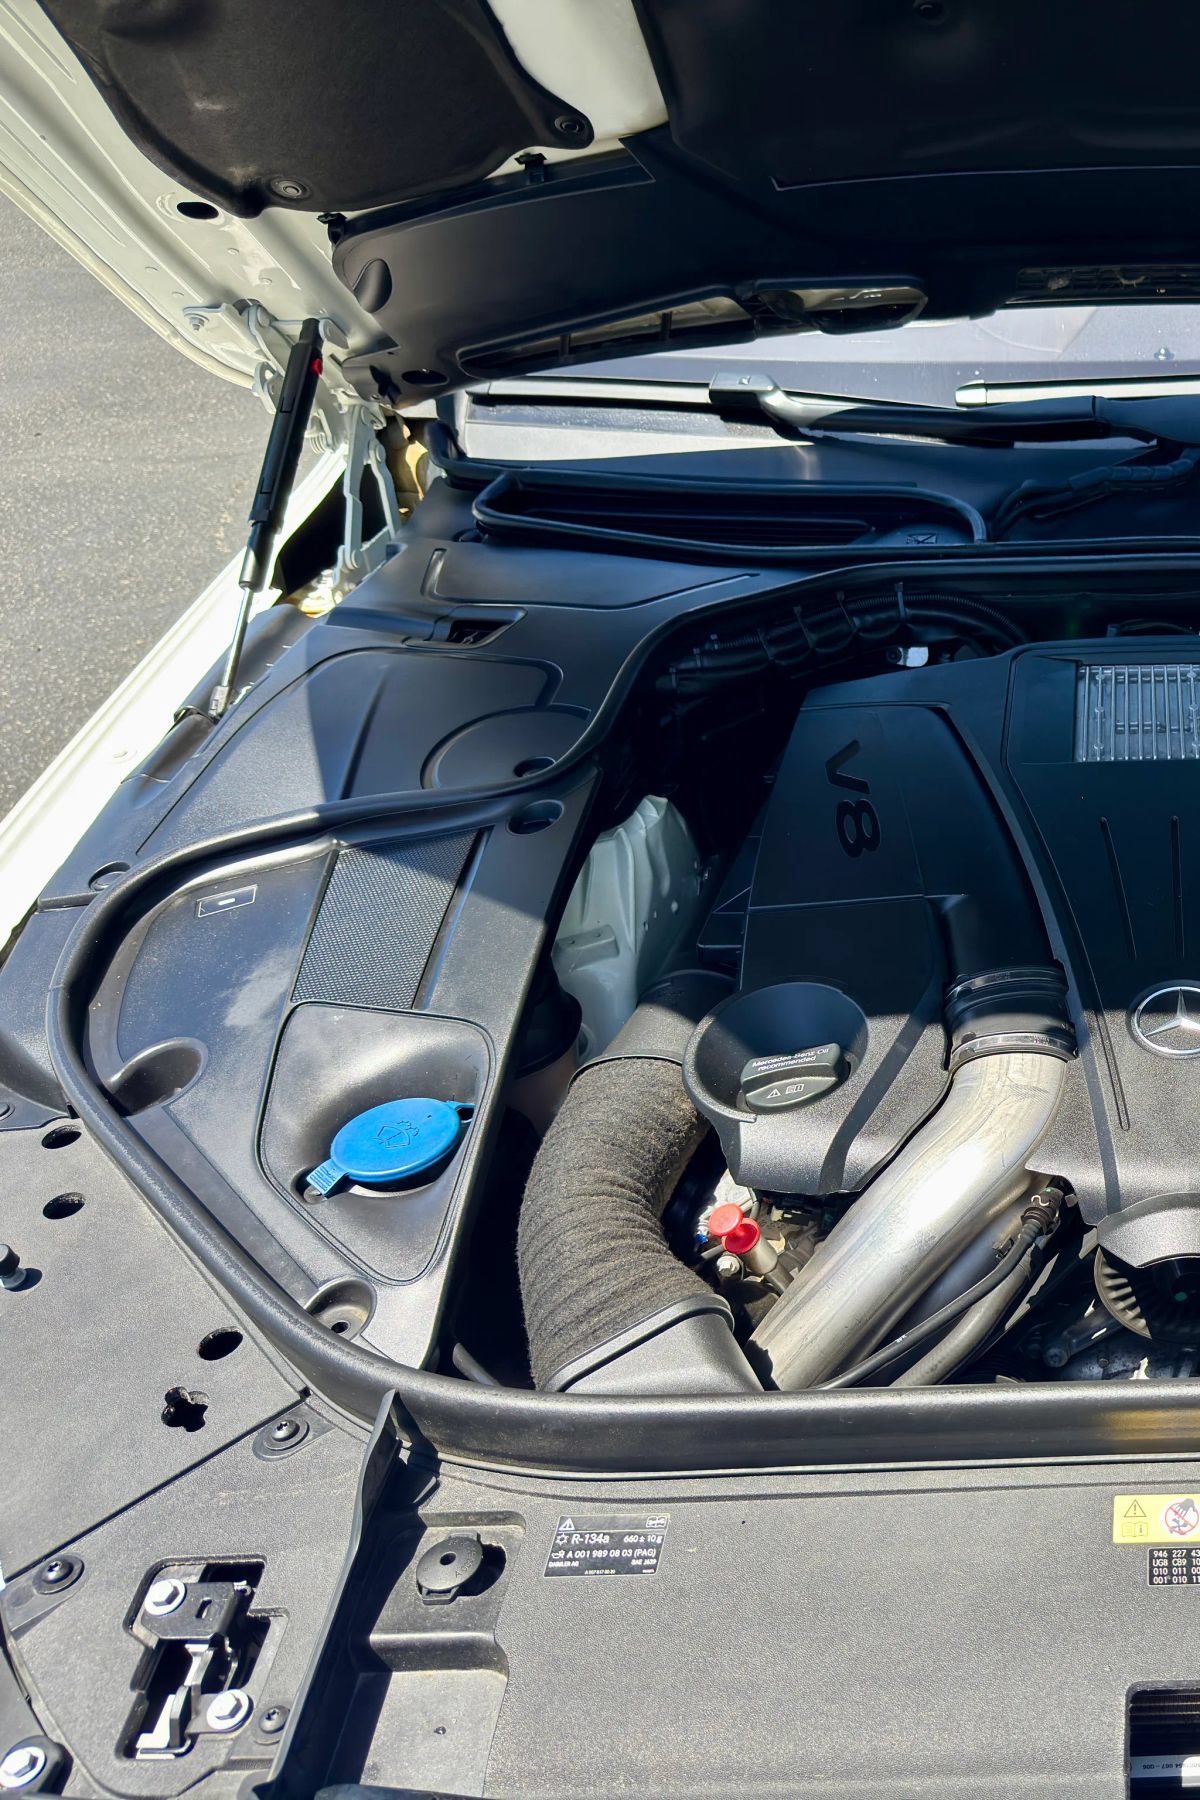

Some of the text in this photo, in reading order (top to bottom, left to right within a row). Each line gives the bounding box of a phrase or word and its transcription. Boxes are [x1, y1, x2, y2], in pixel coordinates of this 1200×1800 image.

[825, 739, 881, 858] V8
[752, 1051, 816, 1067] Mercedes-Benz
[758, 1055, 816, 1071] recommended
[571, 1533, 610, 1545] R-134a
[623, 1535, 638, 1543] 660
[574, 1550, 590, 1558] 001
[592, 1549, 608, 1558] 989
[609, 1549, 620, 1558] 08
[621, 1549, 632, 1557] 03
[633, 1548, 656, 1558] (PAG)
[1153, 1550, 1168, 1558] 946
[1172, 1549, 1187, 1557] 227
[1153, 1567, 1168, 1575] 010
[1172, 1567, 1187, 1575] 011
[1153, 1576, 1167, 1584] 001
[1172, 1576, 1187, 1584] 010
